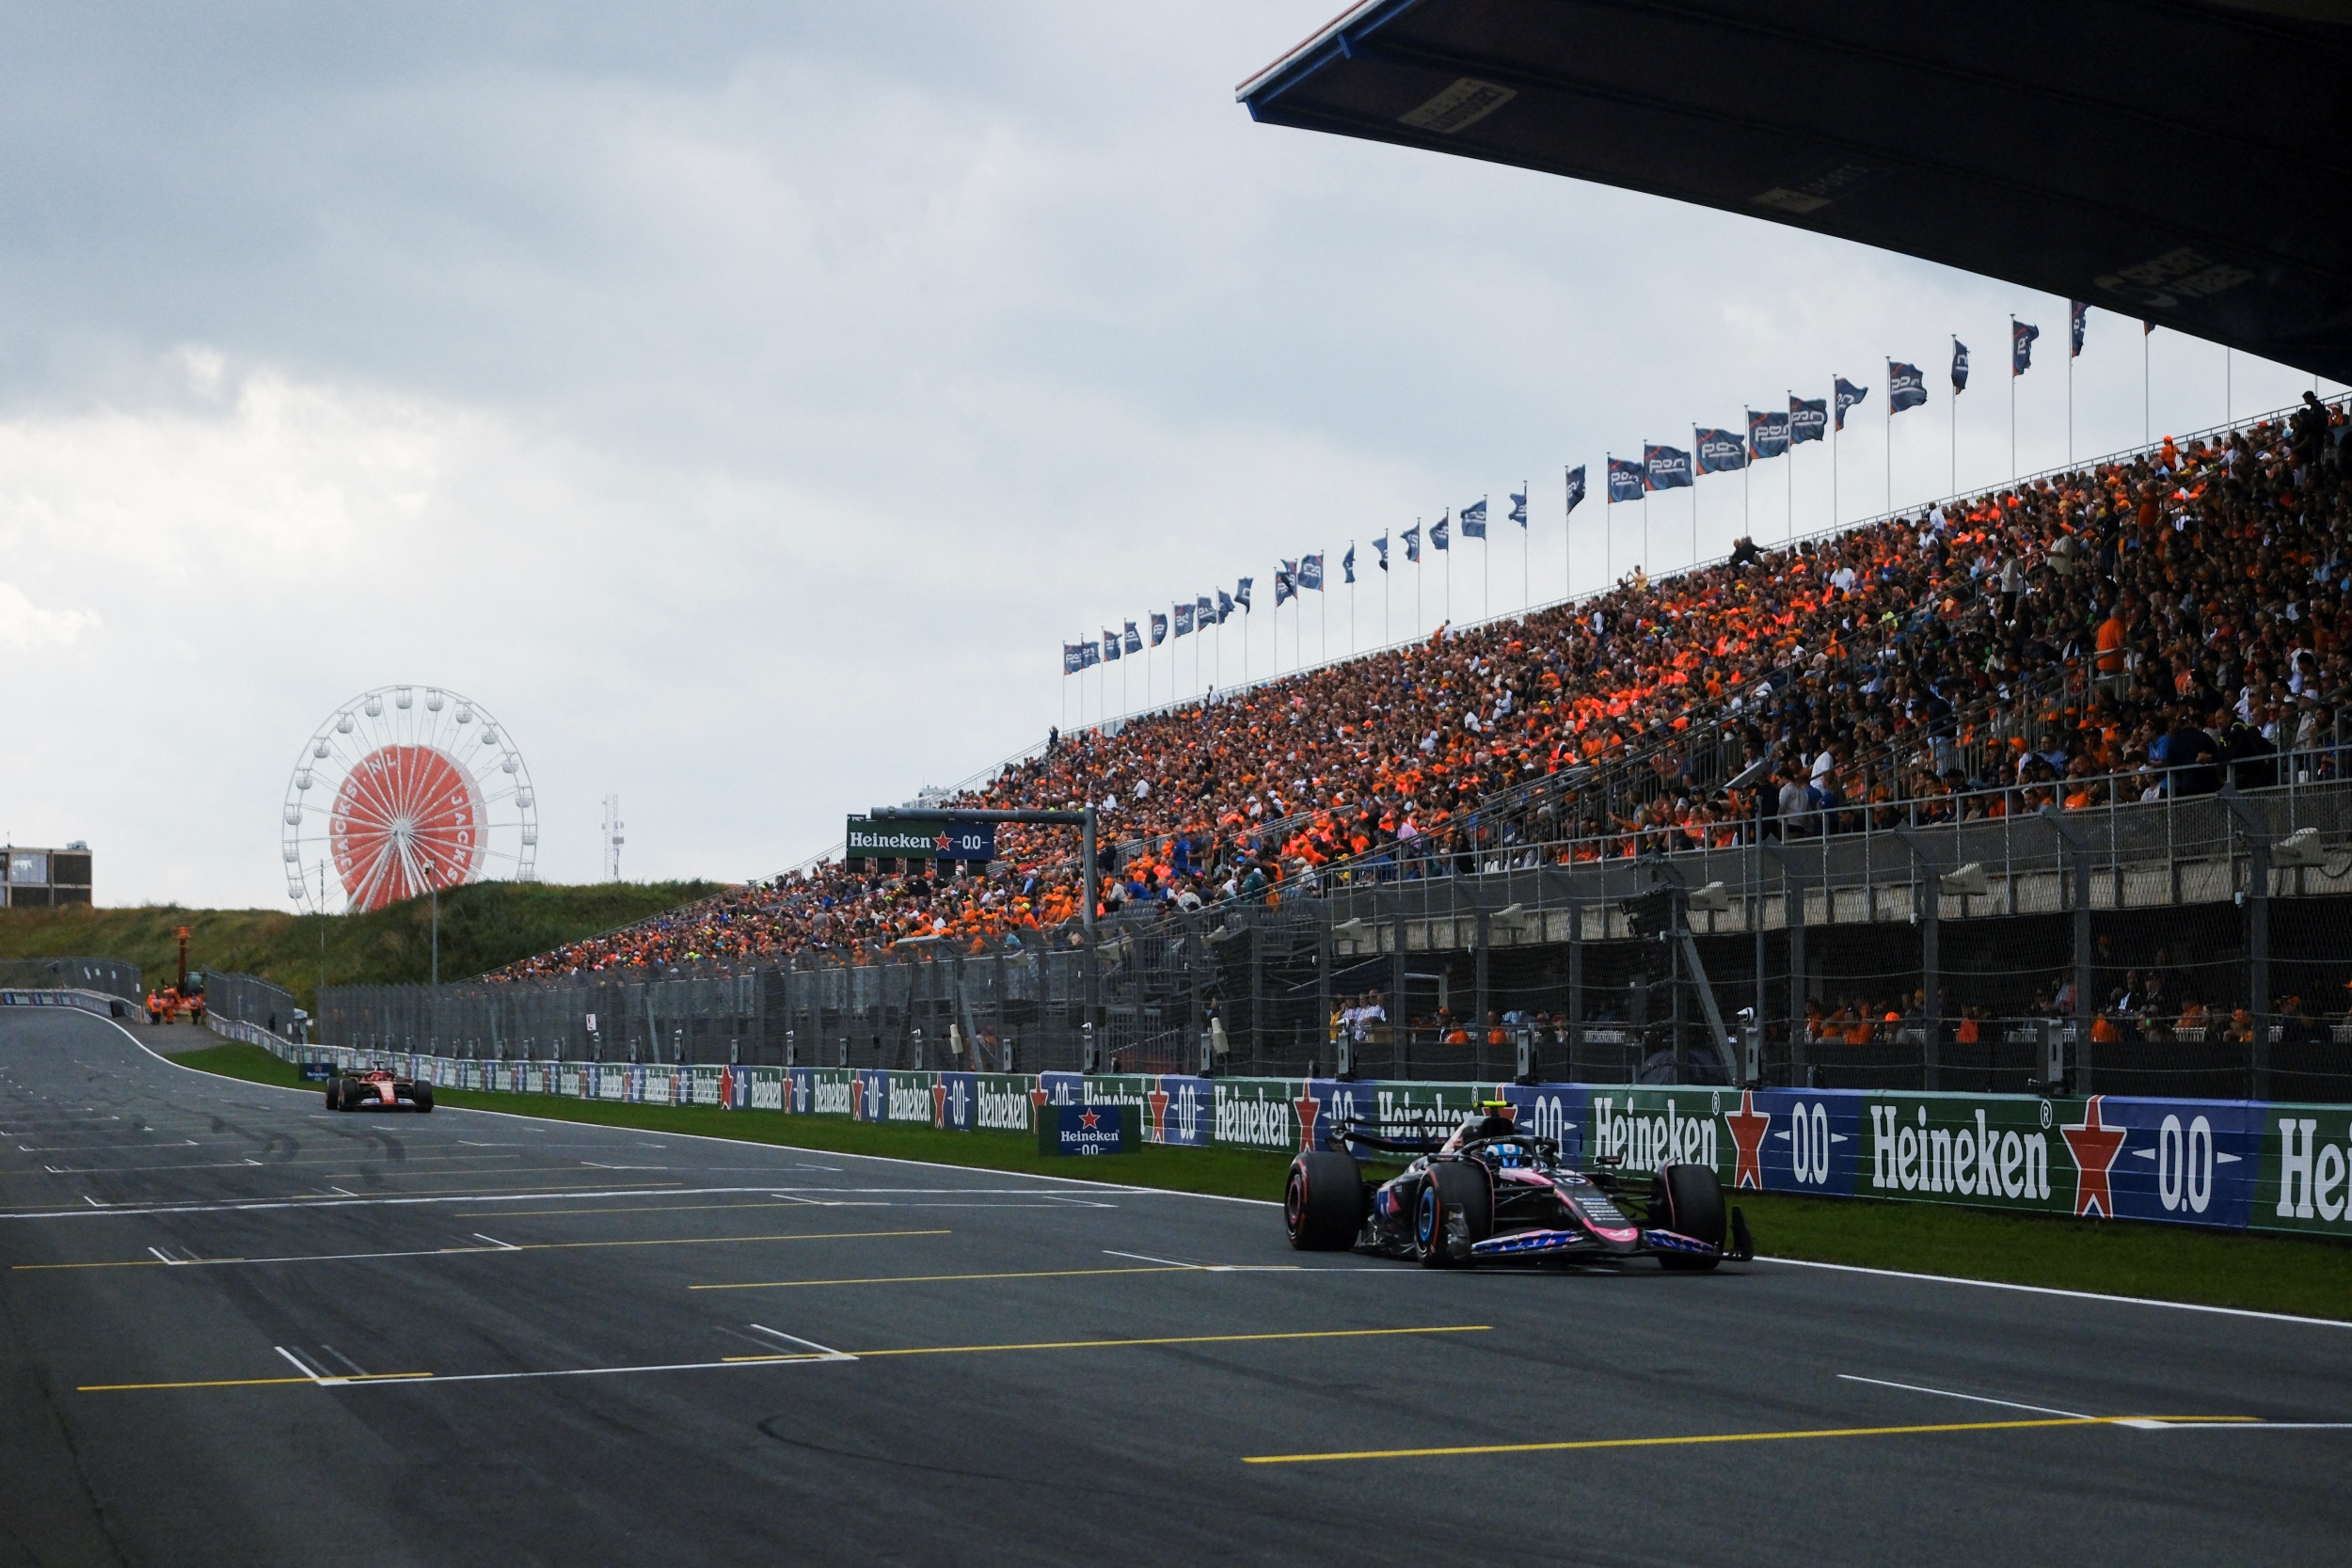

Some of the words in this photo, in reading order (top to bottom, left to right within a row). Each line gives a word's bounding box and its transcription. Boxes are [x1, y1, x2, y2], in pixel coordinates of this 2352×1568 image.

[1649, 457, 1685, 474] pon
[850, 832, 930, 848] Heineken
[814, 1073, 850, 1114] Heineken
[888, 1077, 931, 1122] Heineken
[977, 1081, 1028, 1131] Heineken
[1060, 1131, 1119, 1142] Heineken
[1215, 1085, 1291, 1148] Heineken
[1594, 1097, 1719, 1175] Heineken
[1792, 1101, 1829, 1185] 0.0
[1869, 1104, 2051, 1200] Heineken
[2158, 1114, 2213, 1213] 0.0
